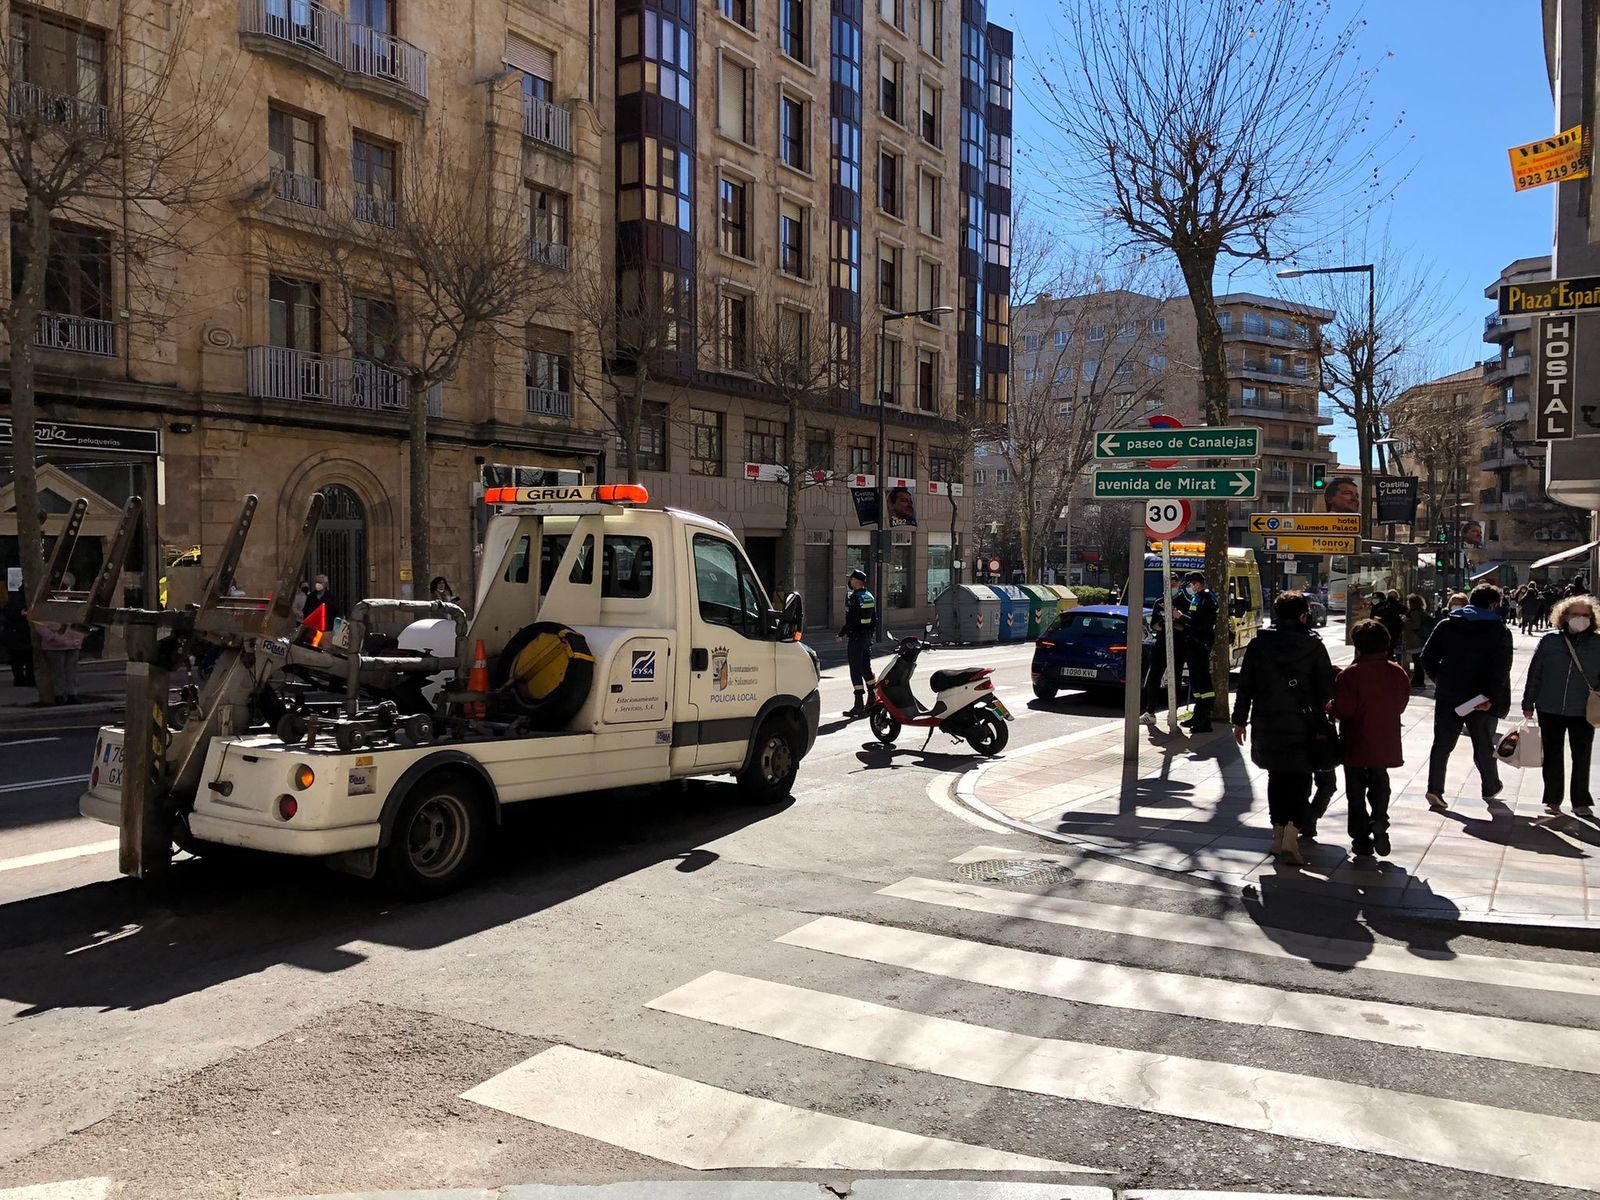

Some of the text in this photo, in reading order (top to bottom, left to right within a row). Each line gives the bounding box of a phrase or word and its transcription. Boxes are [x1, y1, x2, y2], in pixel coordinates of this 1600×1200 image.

[1519, 173, 1542, 188] 923
[1545, 165, 1568, 181] 219
[1508, 287, 1552, 311] Plaza
[1544, 322, 1569, 433] HOSTAL
[1127, 436, 1254, 451] paseo de Canalejas
[1098, 478, 1217, 490] avenida de Mirat
[527, 488, 582, 500] GRUA
[1149, 505, 1177, 522] 30
[1312, 539, 1350, 548] Monroy
[711, 693, 758, 703] POLICIA LOCAL
